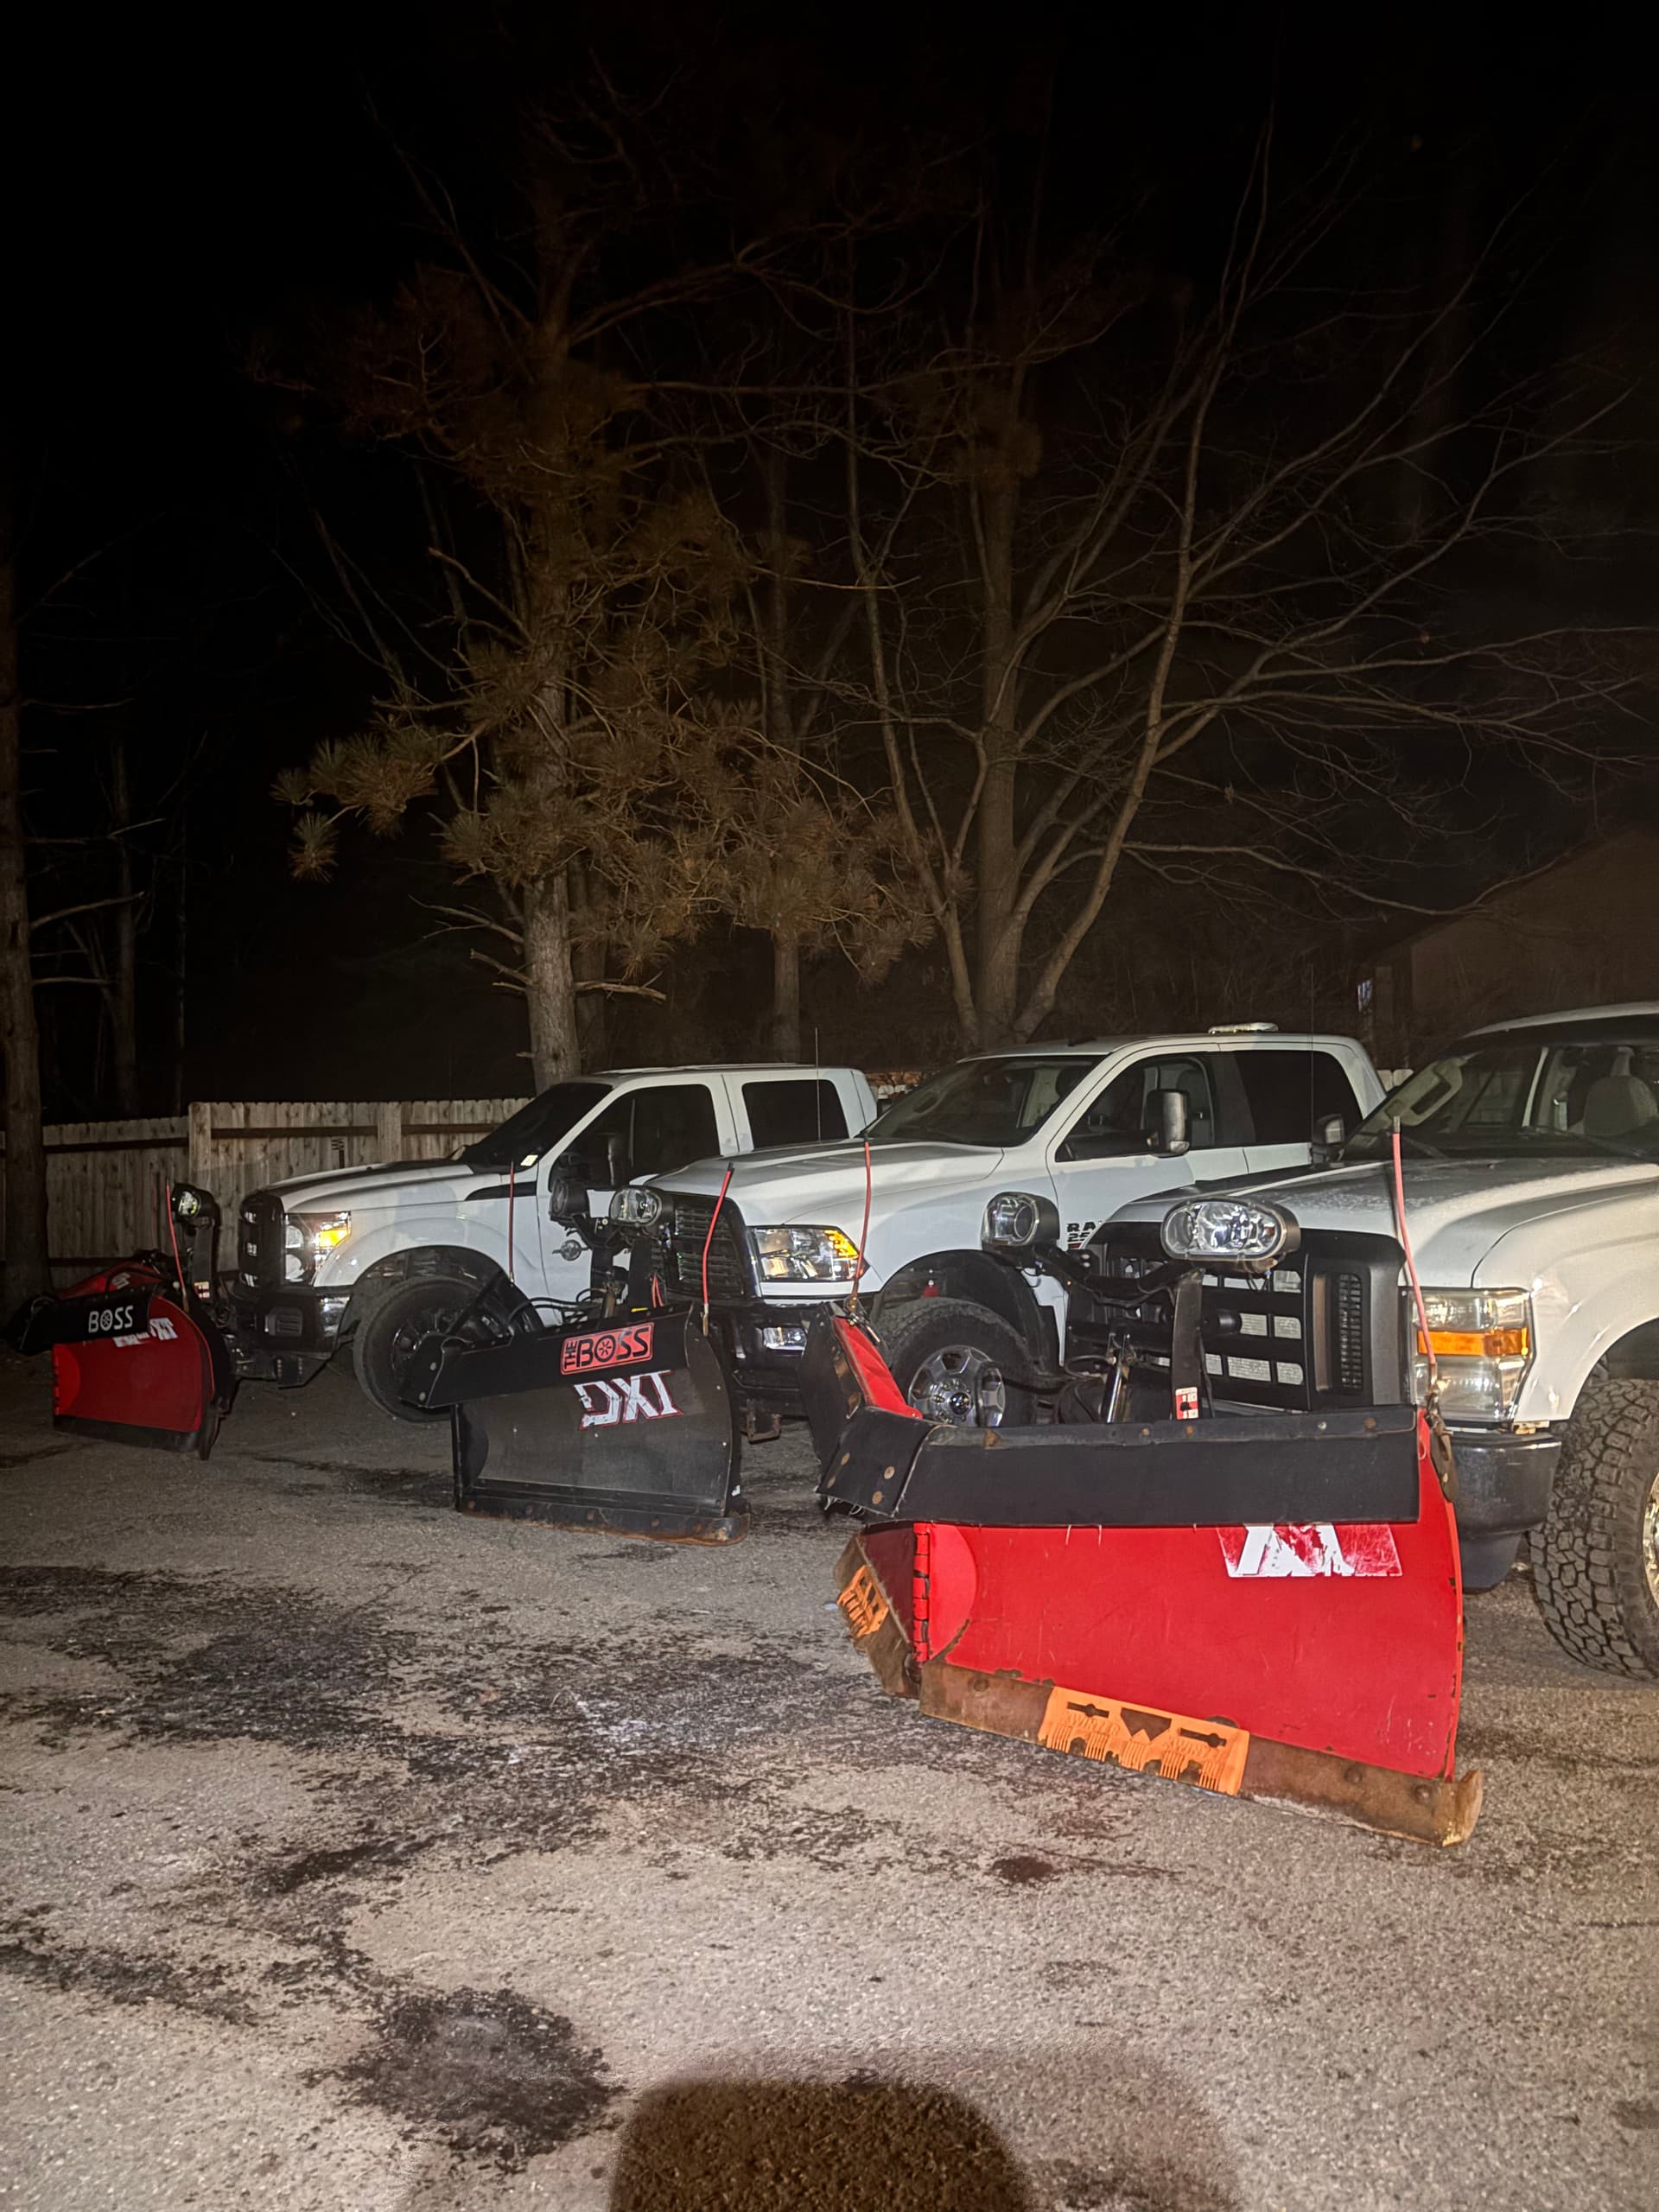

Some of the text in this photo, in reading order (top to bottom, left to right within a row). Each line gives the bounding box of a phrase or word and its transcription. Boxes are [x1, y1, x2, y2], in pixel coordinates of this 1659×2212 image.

[1066, 1221, 1102, 1232] RA
[1067, 1233, 1090, 1242] 25
[88, 1306, 134, 1332] BOSS
[563, 1327, 649, 1370] THE BOSS
